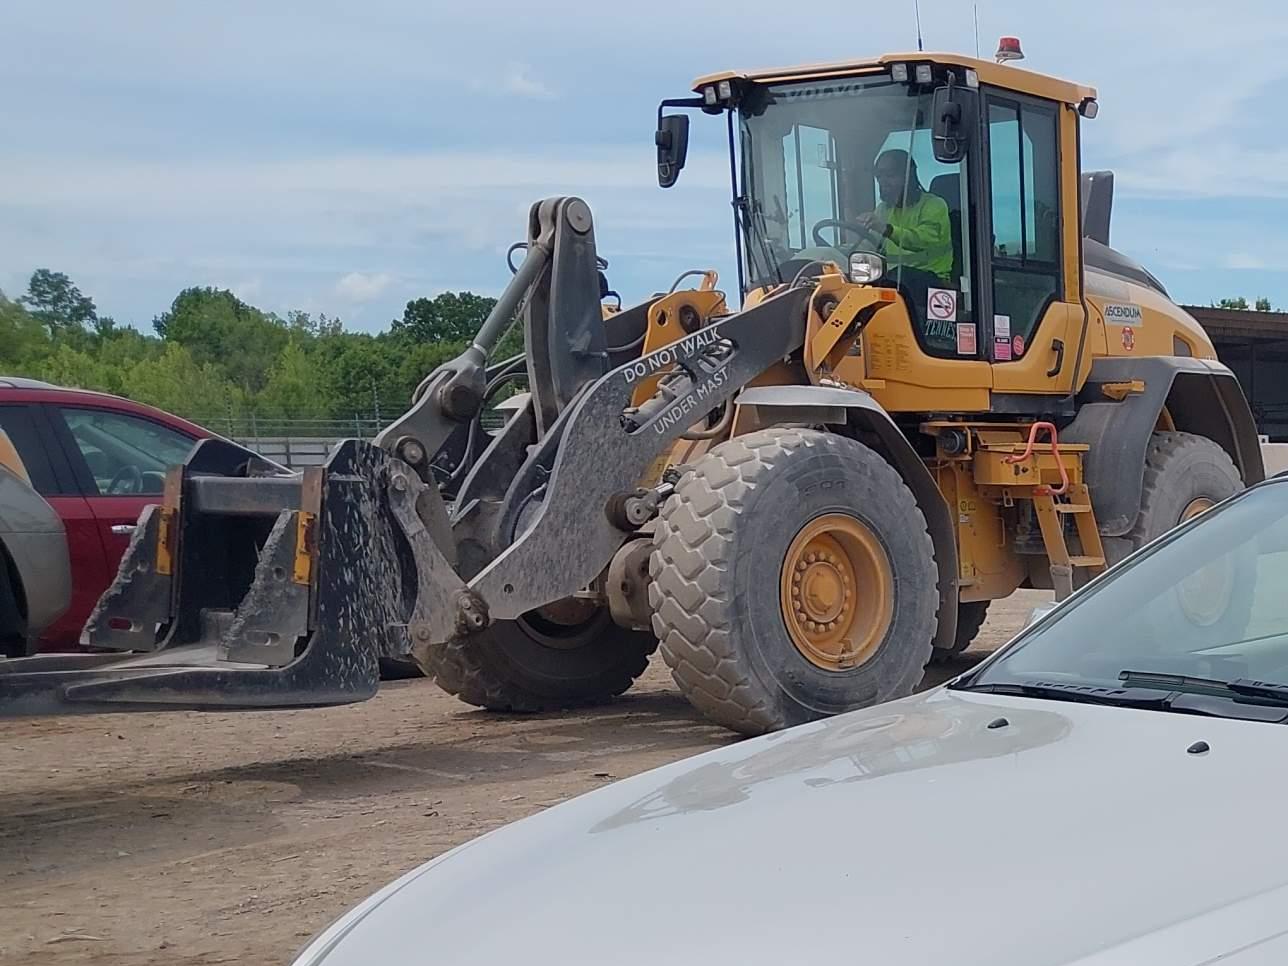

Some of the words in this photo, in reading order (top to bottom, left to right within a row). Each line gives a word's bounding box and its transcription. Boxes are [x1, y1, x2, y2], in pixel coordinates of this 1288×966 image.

[1104, 305, 1142, 319] ASCENDUM
[623, 362, 646, 383] DO
[648, 346, 678, 371] NOT
[680, 327, 721, 355] WALK
[653, 396, 698, 434] UNDER
[696, 366, 729, 400] MAST
